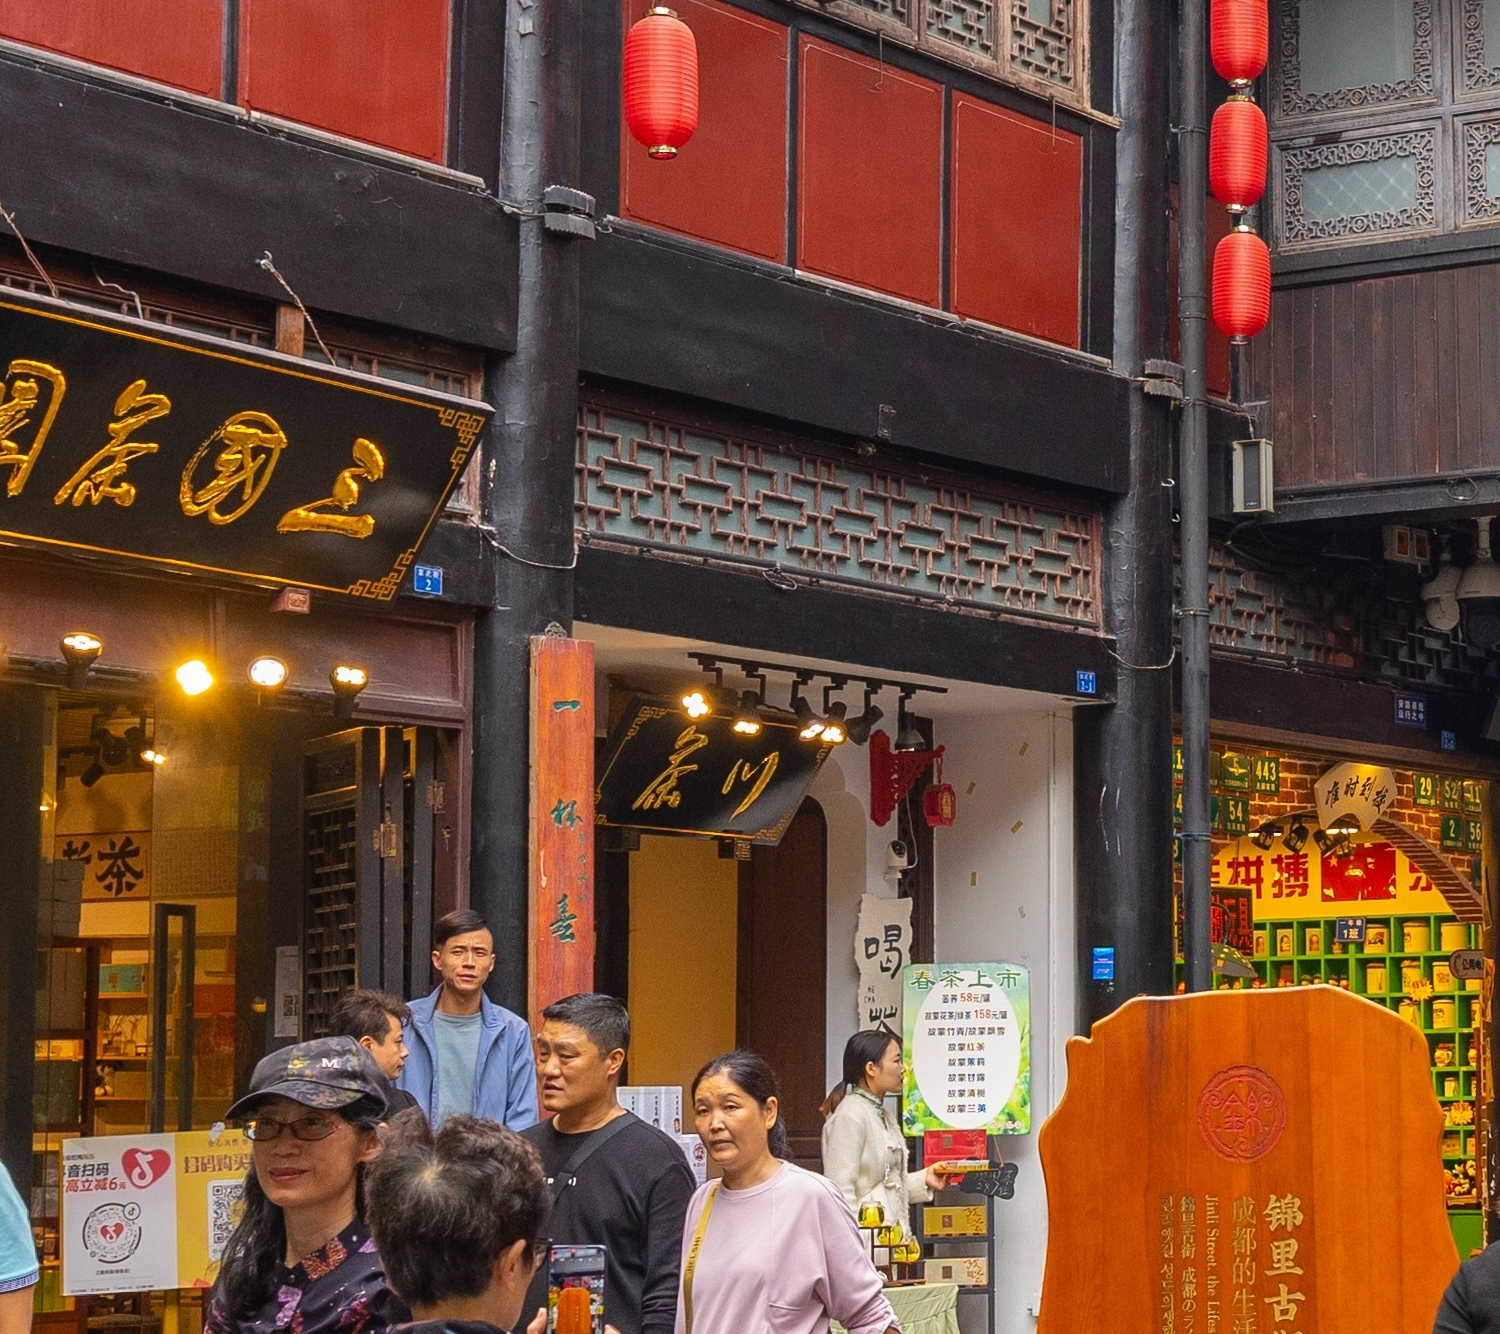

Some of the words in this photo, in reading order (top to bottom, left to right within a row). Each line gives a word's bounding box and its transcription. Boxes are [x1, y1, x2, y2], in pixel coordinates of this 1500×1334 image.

[425, 579, 432, 590] 2
[1256, 761, 1276, 781] 443
[1420, 777, 1432, 796] 29
[1229, 801, 1243, 821] 54
[1449, 820, 1456, 837] 2
[1462, 959, 1483, 971] 公用电
[911, 969, 1021, 989] 春茶上市
[321, 1058, 341, 1068] M
[63, 1163, 110, 1178] 音扫码
[63, 1177, 126, 1193] 高立减6元
[1205, 1194, 1220, 1224] Jinli
[1207, 1275, 1220, 1297] the
